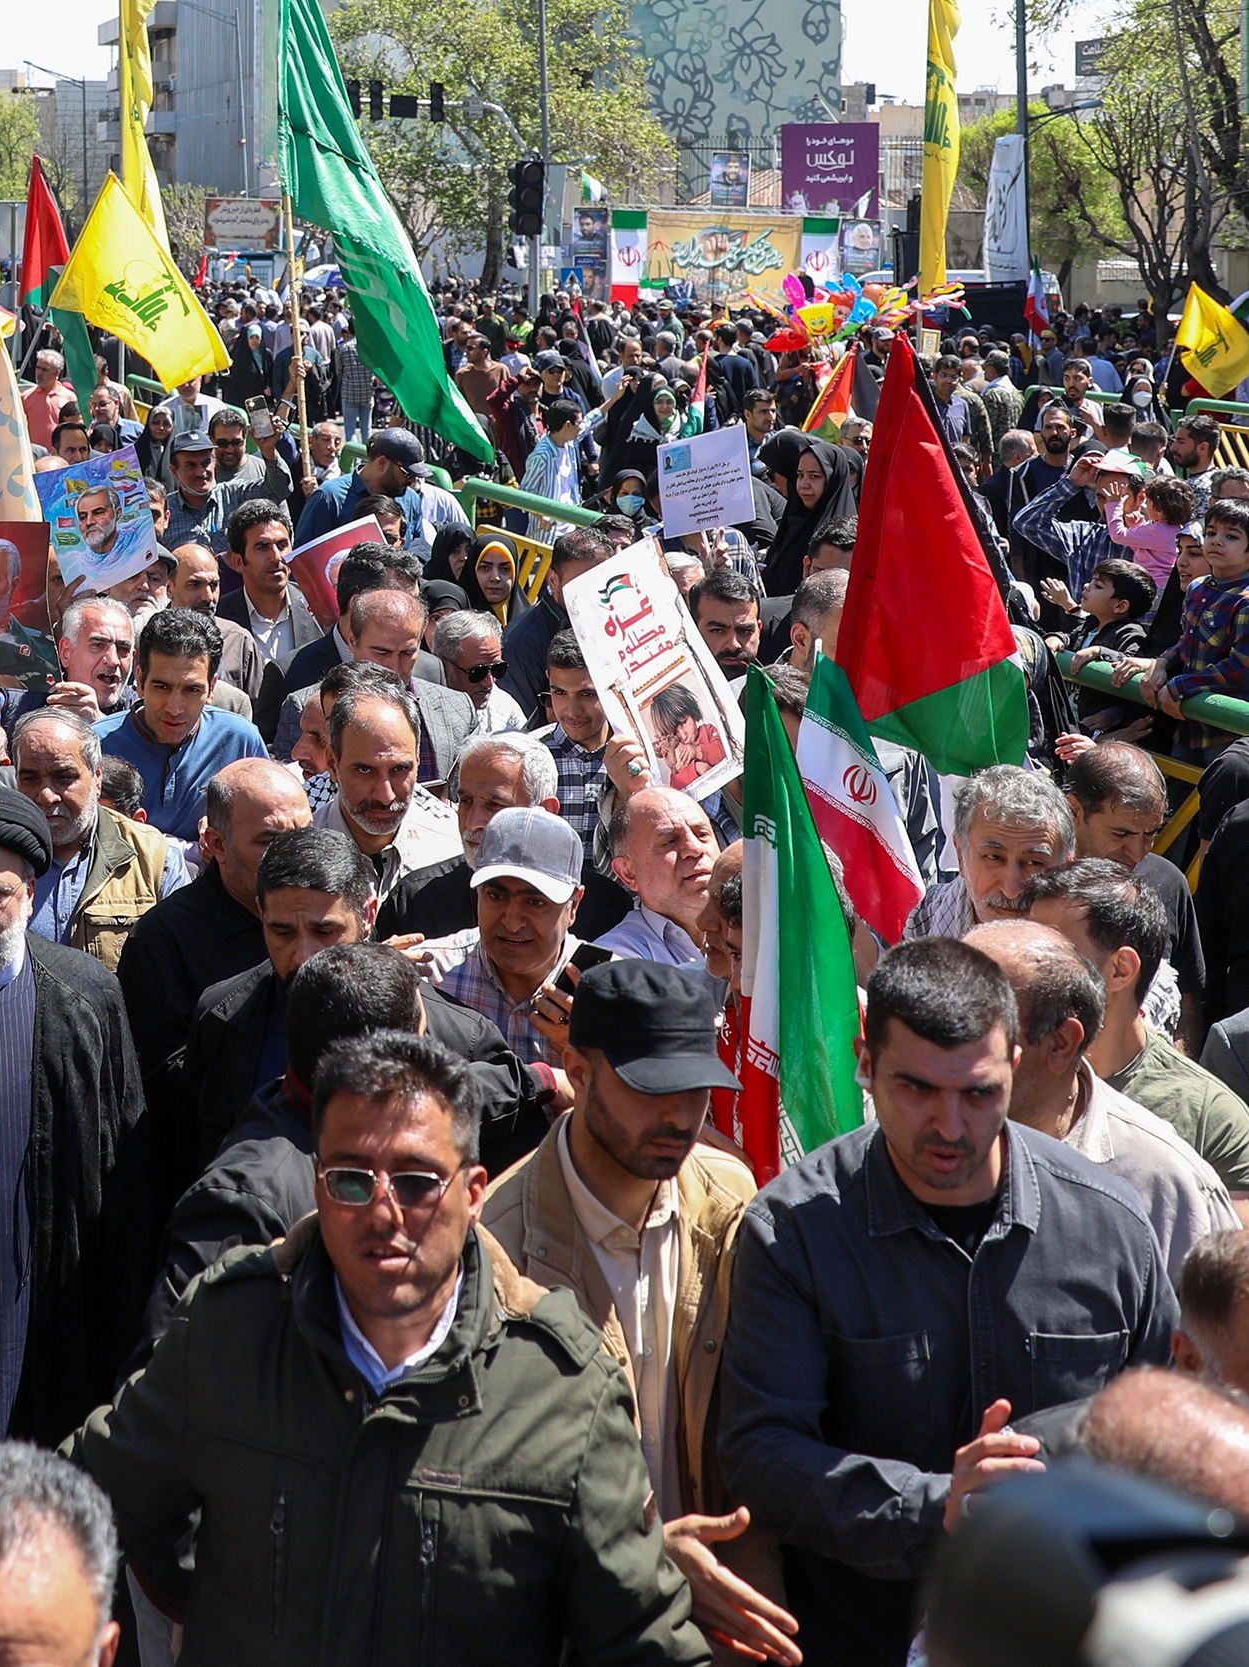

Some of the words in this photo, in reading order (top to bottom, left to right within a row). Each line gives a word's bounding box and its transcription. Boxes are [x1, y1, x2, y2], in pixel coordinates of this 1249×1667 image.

[806, 137, 812, 146] را
[812, 137, 827, 146] خود
[827, 137, 854, 146] موهای
[806, 150, 854, 171] لوکس
[805, 174, 820, 183] کنید
[604, 587, 654, 641] غزه
[618, 623, 666, 664] مظلوم
[625, 638, 674, 680] مقتدر
